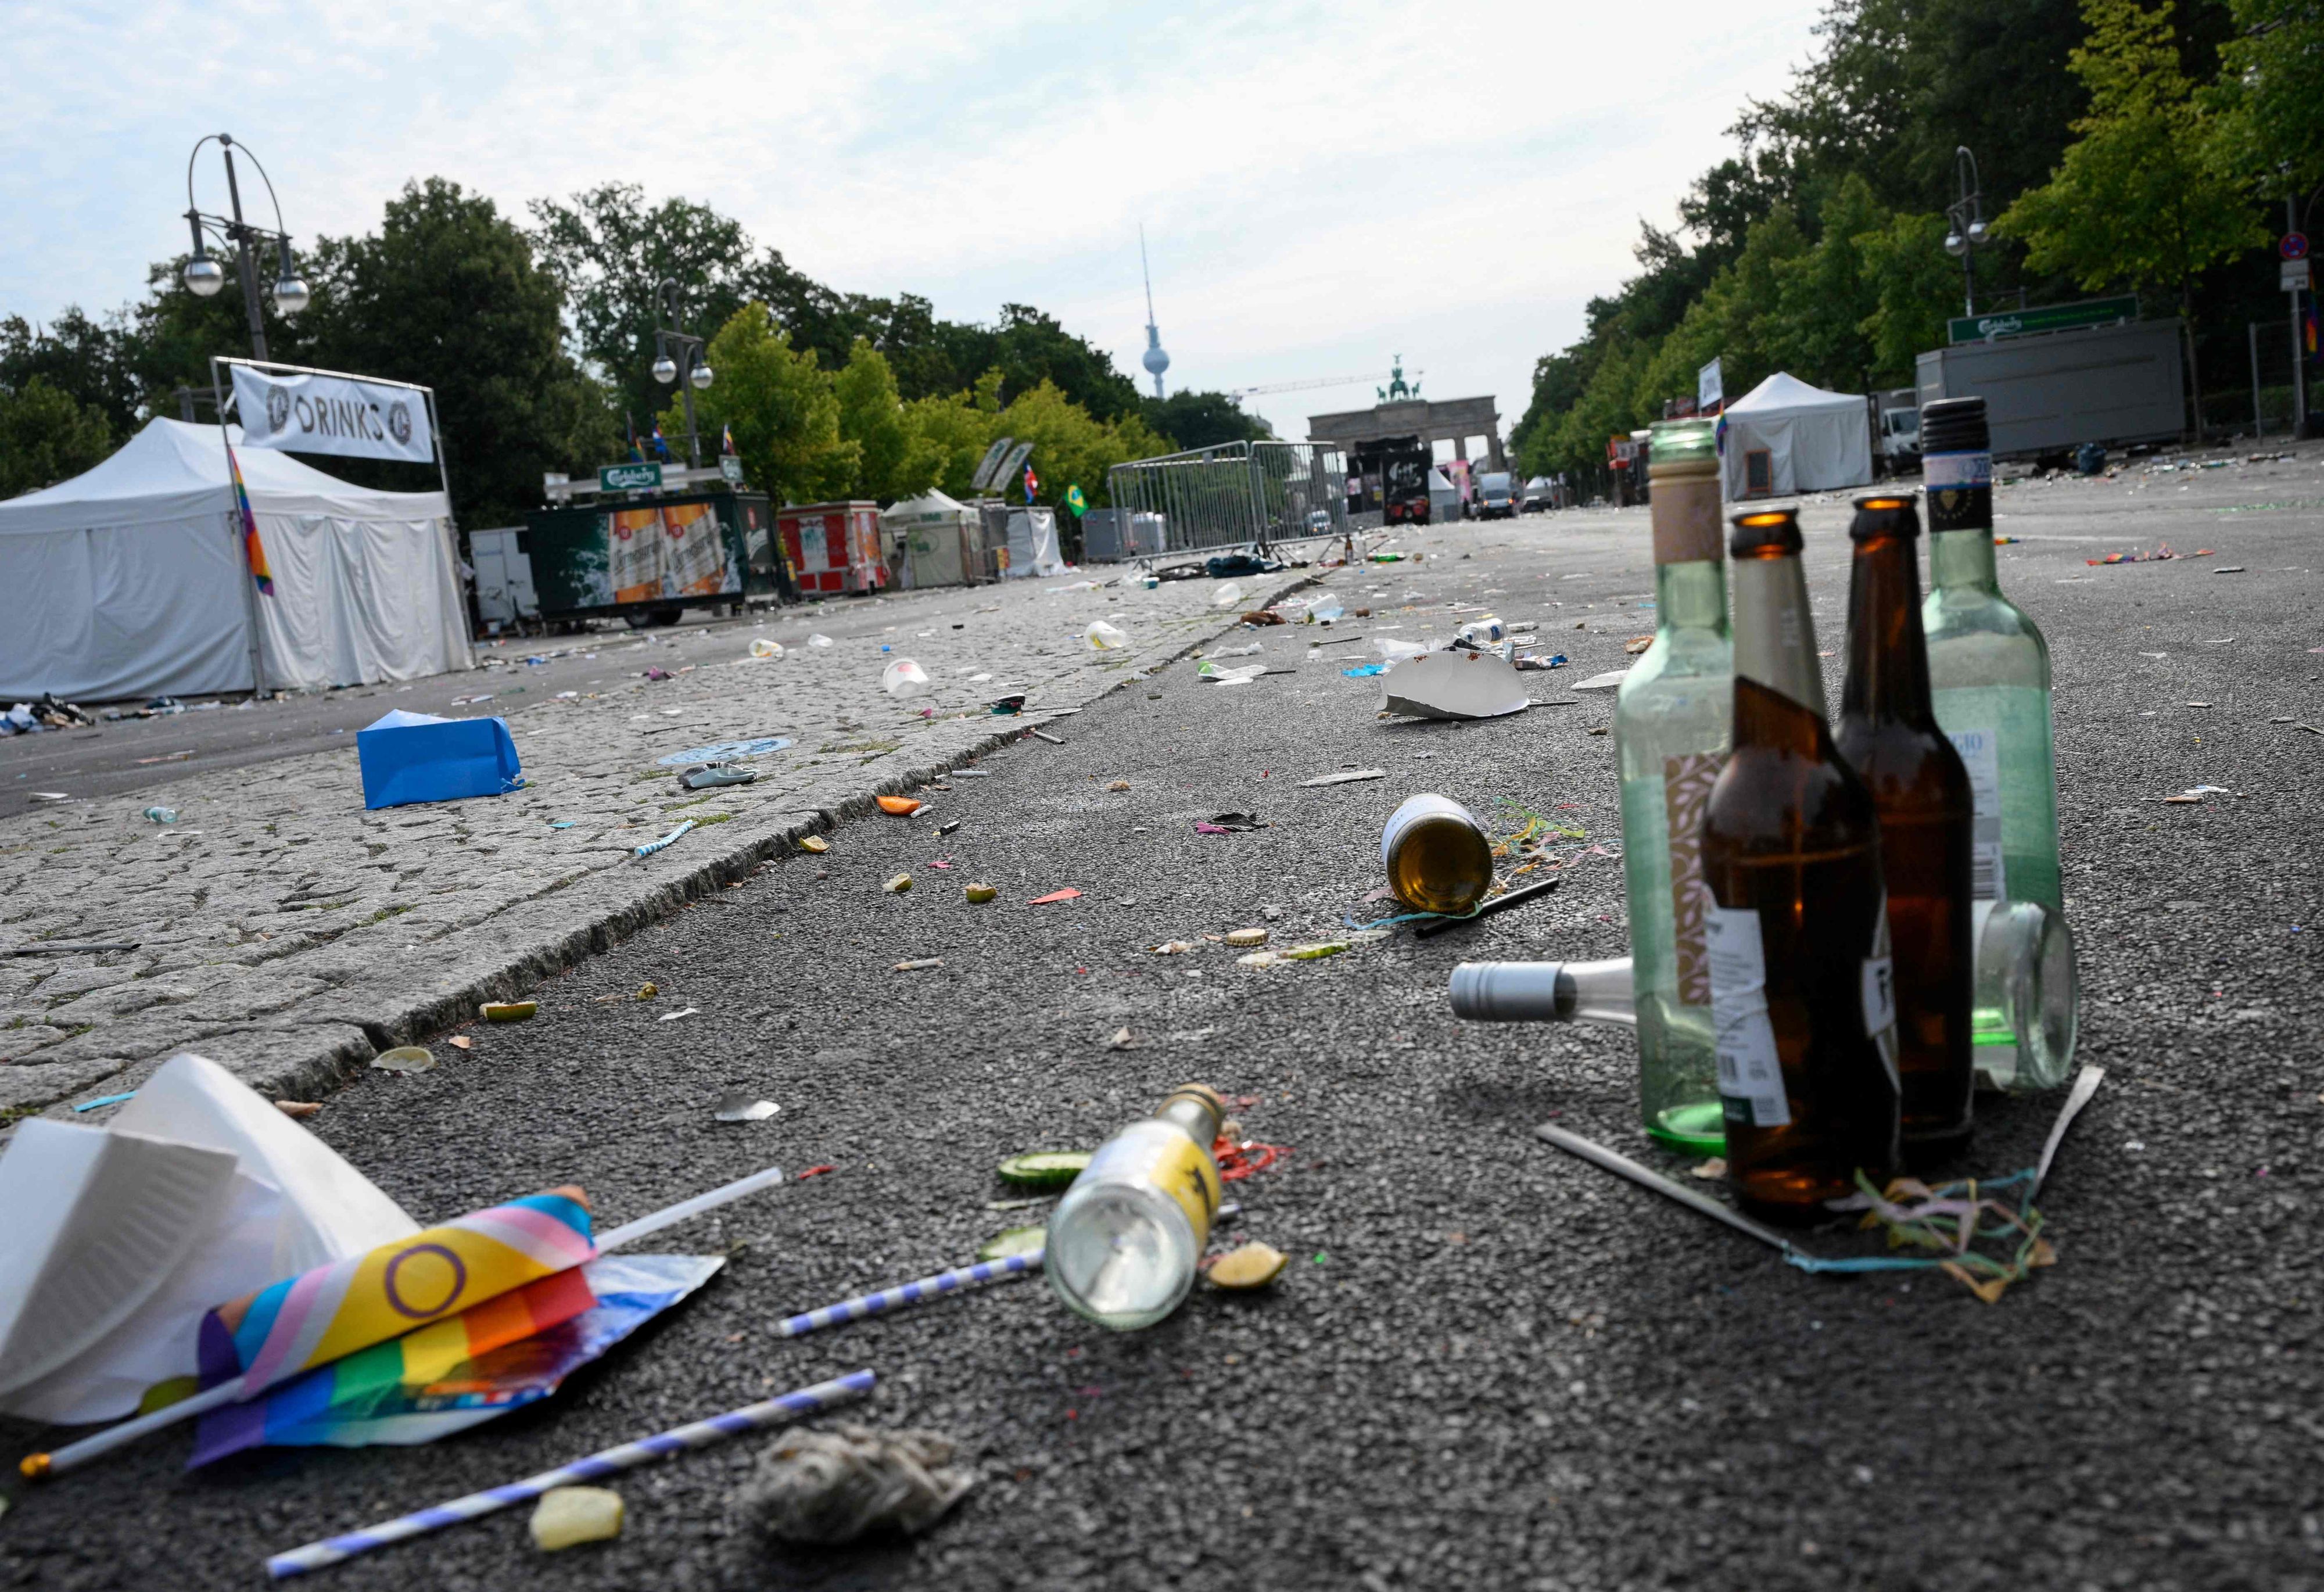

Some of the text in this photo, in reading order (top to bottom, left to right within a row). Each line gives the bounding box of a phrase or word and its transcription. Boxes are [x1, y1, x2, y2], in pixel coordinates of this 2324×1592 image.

[1977, 316, 2023, 336] Carlsberg
[295, 395, 384, 441] DRINKS
[607, 467, 655, 488] Carlsberg
